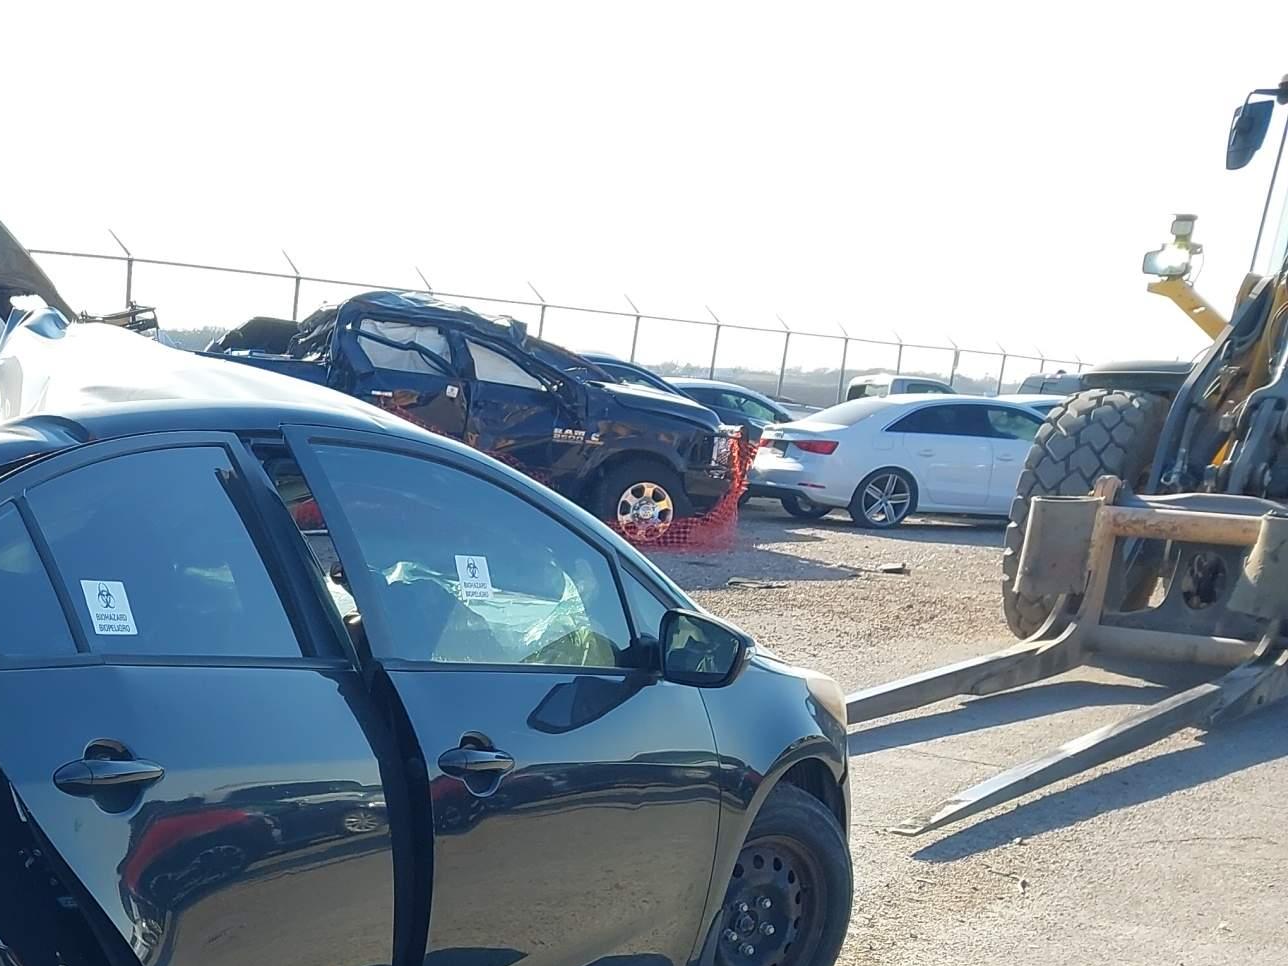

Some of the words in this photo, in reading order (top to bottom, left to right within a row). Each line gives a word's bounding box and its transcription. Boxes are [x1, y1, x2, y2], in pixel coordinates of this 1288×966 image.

[553, 427, 586, 437] RAM
[96, 612, 128, 622] BIOHAZARD
[98, 623, 131, 633] BIOPELIGRO
